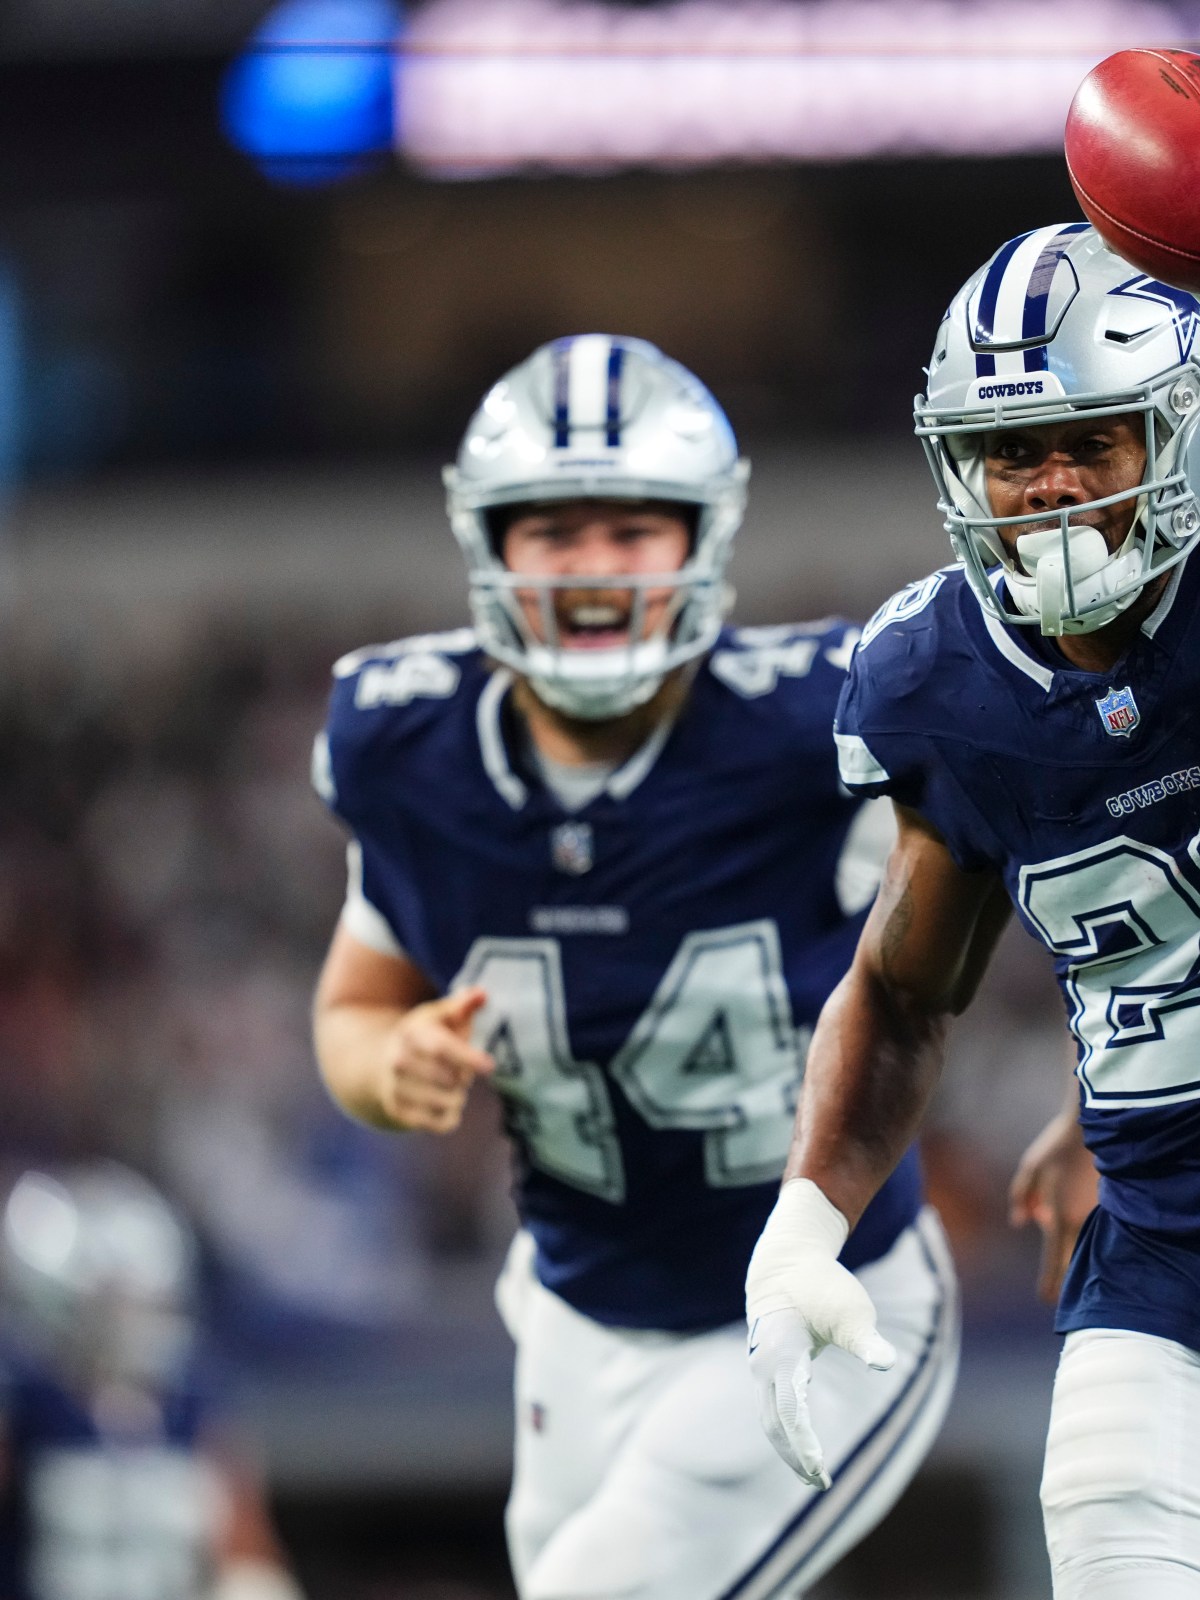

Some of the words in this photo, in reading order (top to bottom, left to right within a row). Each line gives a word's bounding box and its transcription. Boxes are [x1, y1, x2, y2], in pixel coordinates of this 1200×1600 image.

[978, 381, 1044, 400] COWBOYS
[1107, 707, 1135, 731] NFL
[447, 917, 820, 1205] 44
